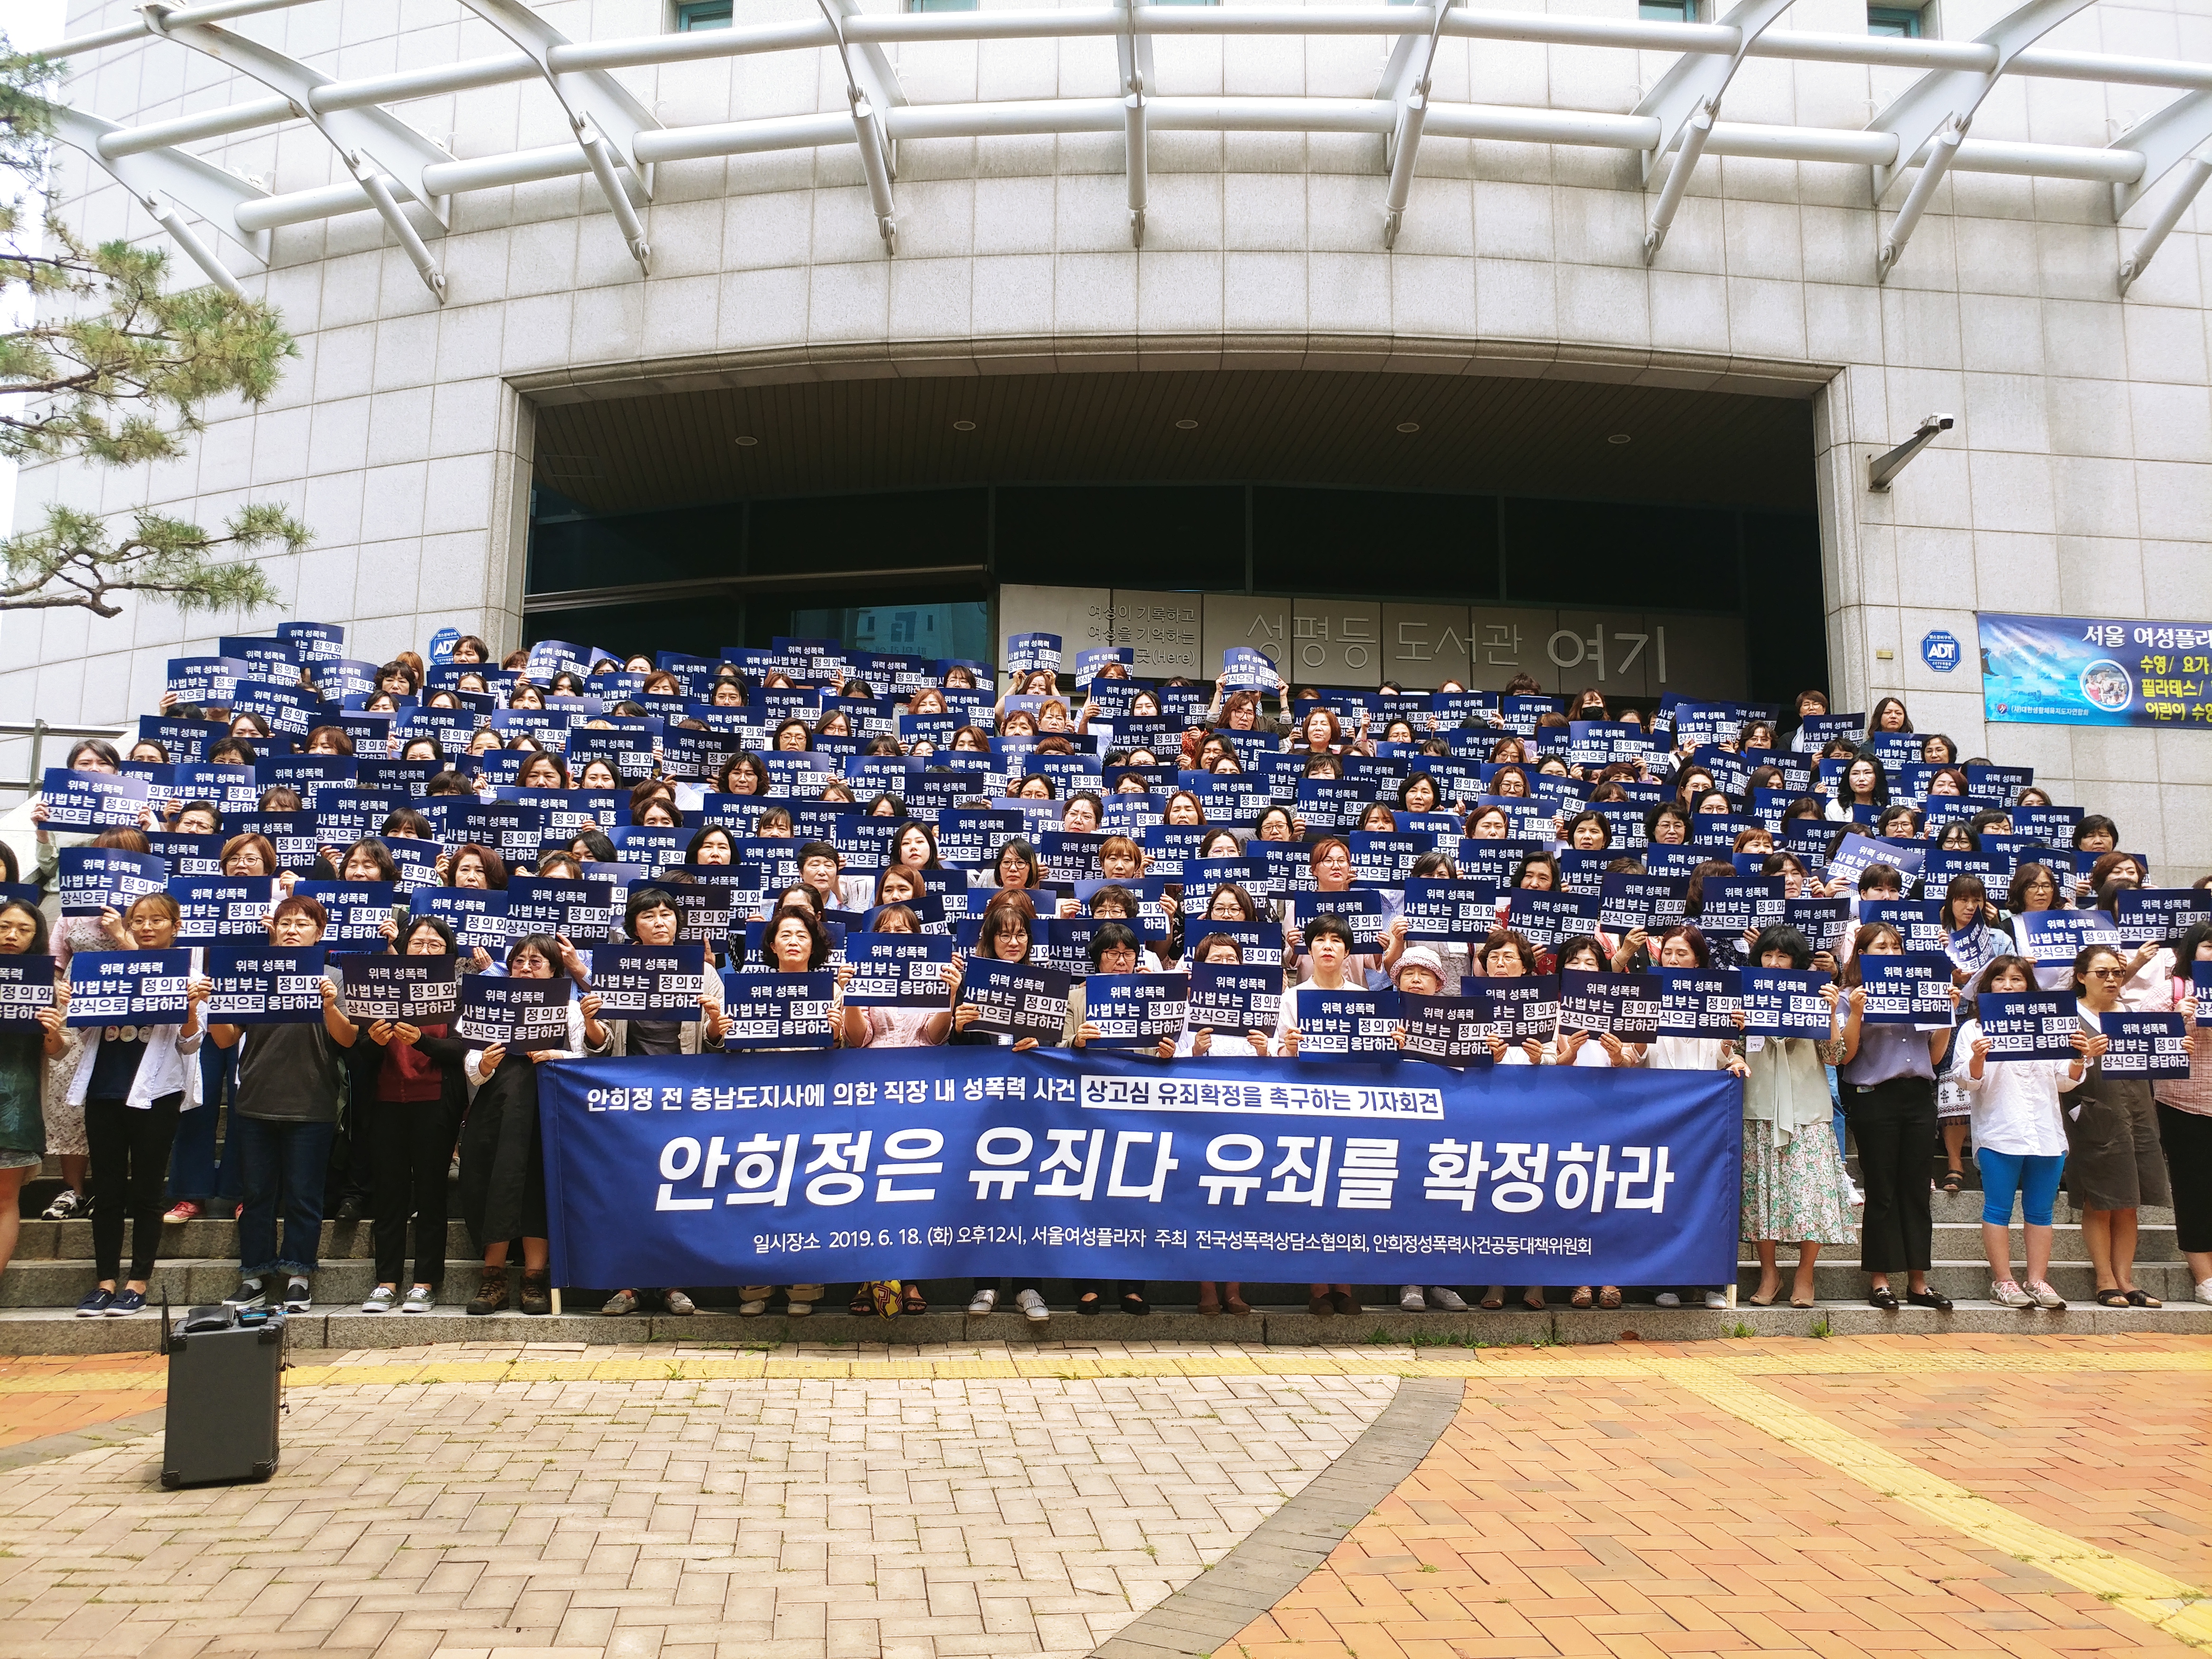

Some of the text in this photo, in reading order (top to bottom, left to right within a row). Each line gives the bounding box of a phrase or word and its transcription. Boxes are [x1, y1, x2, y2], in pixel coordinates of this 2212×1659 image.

[1088, 604, 1194, 622] 여성이 기록하고
[1088, 626, 1195, 644] 여성을 기억하는
[2082, 625, 2125, 648] 서울
[788, 646, 824, 655] 위력 성폭력
[1008, 650, 1060, 659] 사법부는 정의와
[1246, 614, 1667, 684] 성평등 도서관 여기
[1928, 643, 1955, 658] ADT
[772, 656, 840, 667] 사법부는 정의와
[1009, 660, 1058, 671] 상식으로 응답하라
[185, 666, 229, 675] 위력 성폭력
[168, 677, 208, 689] 사법부는
[2145, 702, 2185, 721] 어린이
[1588, 729, 1625, 738] 위력 성폭력
[1678, 722, 1737, 732] 사법부는 정의와
[680, 738, 721, 750] 위력 성폭력
[1572, 740, 1640, 751] 사법부는 정의와
[663, 750, 701, 761] 사법부는
[1572, 752, 1605, 762] 상식으로
[662, 762, 697, 773] 상식으로
[1985, 774, 2021, 783] 위력 성폭력
[68, 781, 124, 794] 위력 성폭력
[1318, 789, 1358, 799] 위력 성폭력
[1969, 784, 2005, 794] 사법부는
[1299, 801, 1338, 810] 사법부는
[467, 815, 518, 827] 위력 성폭력
[959, 820, 1003, 830] 위력 성폭력
[446, 830, 539, 844] 사법부는 정의와
[940, 834, 983, 845] 사법부는
[939, 848, 980, 859] 상식으로
[1426, 889, 1475, 900] 위력 성폭력
[1405, 903, 1452, 916] 사법부는
[2142, 900, 2191, 910] 위력 성폭력
[1407, 918, 1448, 932] 상식으로
[2178, 913, 2210, 924] 정의와
[2119, 927, 2165, 940] 상식으로
[871, 945, 927, 958] 위력 성폭력
[100, 962, 163, 974] 위력 성폭력
[620, 958, 678, 971] 위력 성폭력
[368, 967, 427, 980] 위력 성폭력
[1884, 966, 1932, 978] 위력 성폭력
[71, 980, 133, 995] 사법부는
[593, 974, 703, 990] 사법부는 정의와
[846, 980, 950, 995] 상식으로 응답하라
[989, 973, 1044, 991] 위력 성폭력
[1216, 976, 1266, 990] 위력 성폭력
[1865, 982, 1911, 995] 사법부는
[345, 984, 455, 999] 사법부는 정의와
[486, 990, 544, 1003] 위력 성폭력
[1586, 984, 1640, 997] 위력 성폭력
[69, 997, 189, 1014] 상식으로 응답하라
[964, 986, 1066, 1014] 사법부는 정의와
[1191, 991, 1280, 1008] 사법부는 정의와
[1865, 999, 1951, 1012] 상식으로 응답하라
[347, 1001, 456, 1018] 상식으로 응답하라
[463, 1004, 568, 1022] 사법부는 정의와
[1561, 997, 1661, 1016] 사법부는 정의와
[1014, 1012, 1064, 1031] 응답하라
[1190, 1008, 1278, 1027] 상식으로 응답하라
[1561, 1012, 1658, 1032] 상식으로 응답하라
[463, 1022, 566, 1040] 상식으로 응답하라
[2123, 1024, 2168, 1035] 위력 성폭력
[2102, 1054, 2189, 1069] 상식으로 응답하라
[587, 1078, 1438, 1114] 안희정 전 충남도지사에 의한 직장 내 성폭력 사건 상고심 유죄확정을 촉구하는 기자회견
[654, 1127, 1673, 1213] 안희정은 유죄다 유죄를 확정하라
[753, 1226, 1592, 1256] 일시장소 2019. 6. 18. (화) 오후12시, 서울여성플라자 주최 전국성폭력상담소협의회, 안희정성폭력사건공동대책위원회
